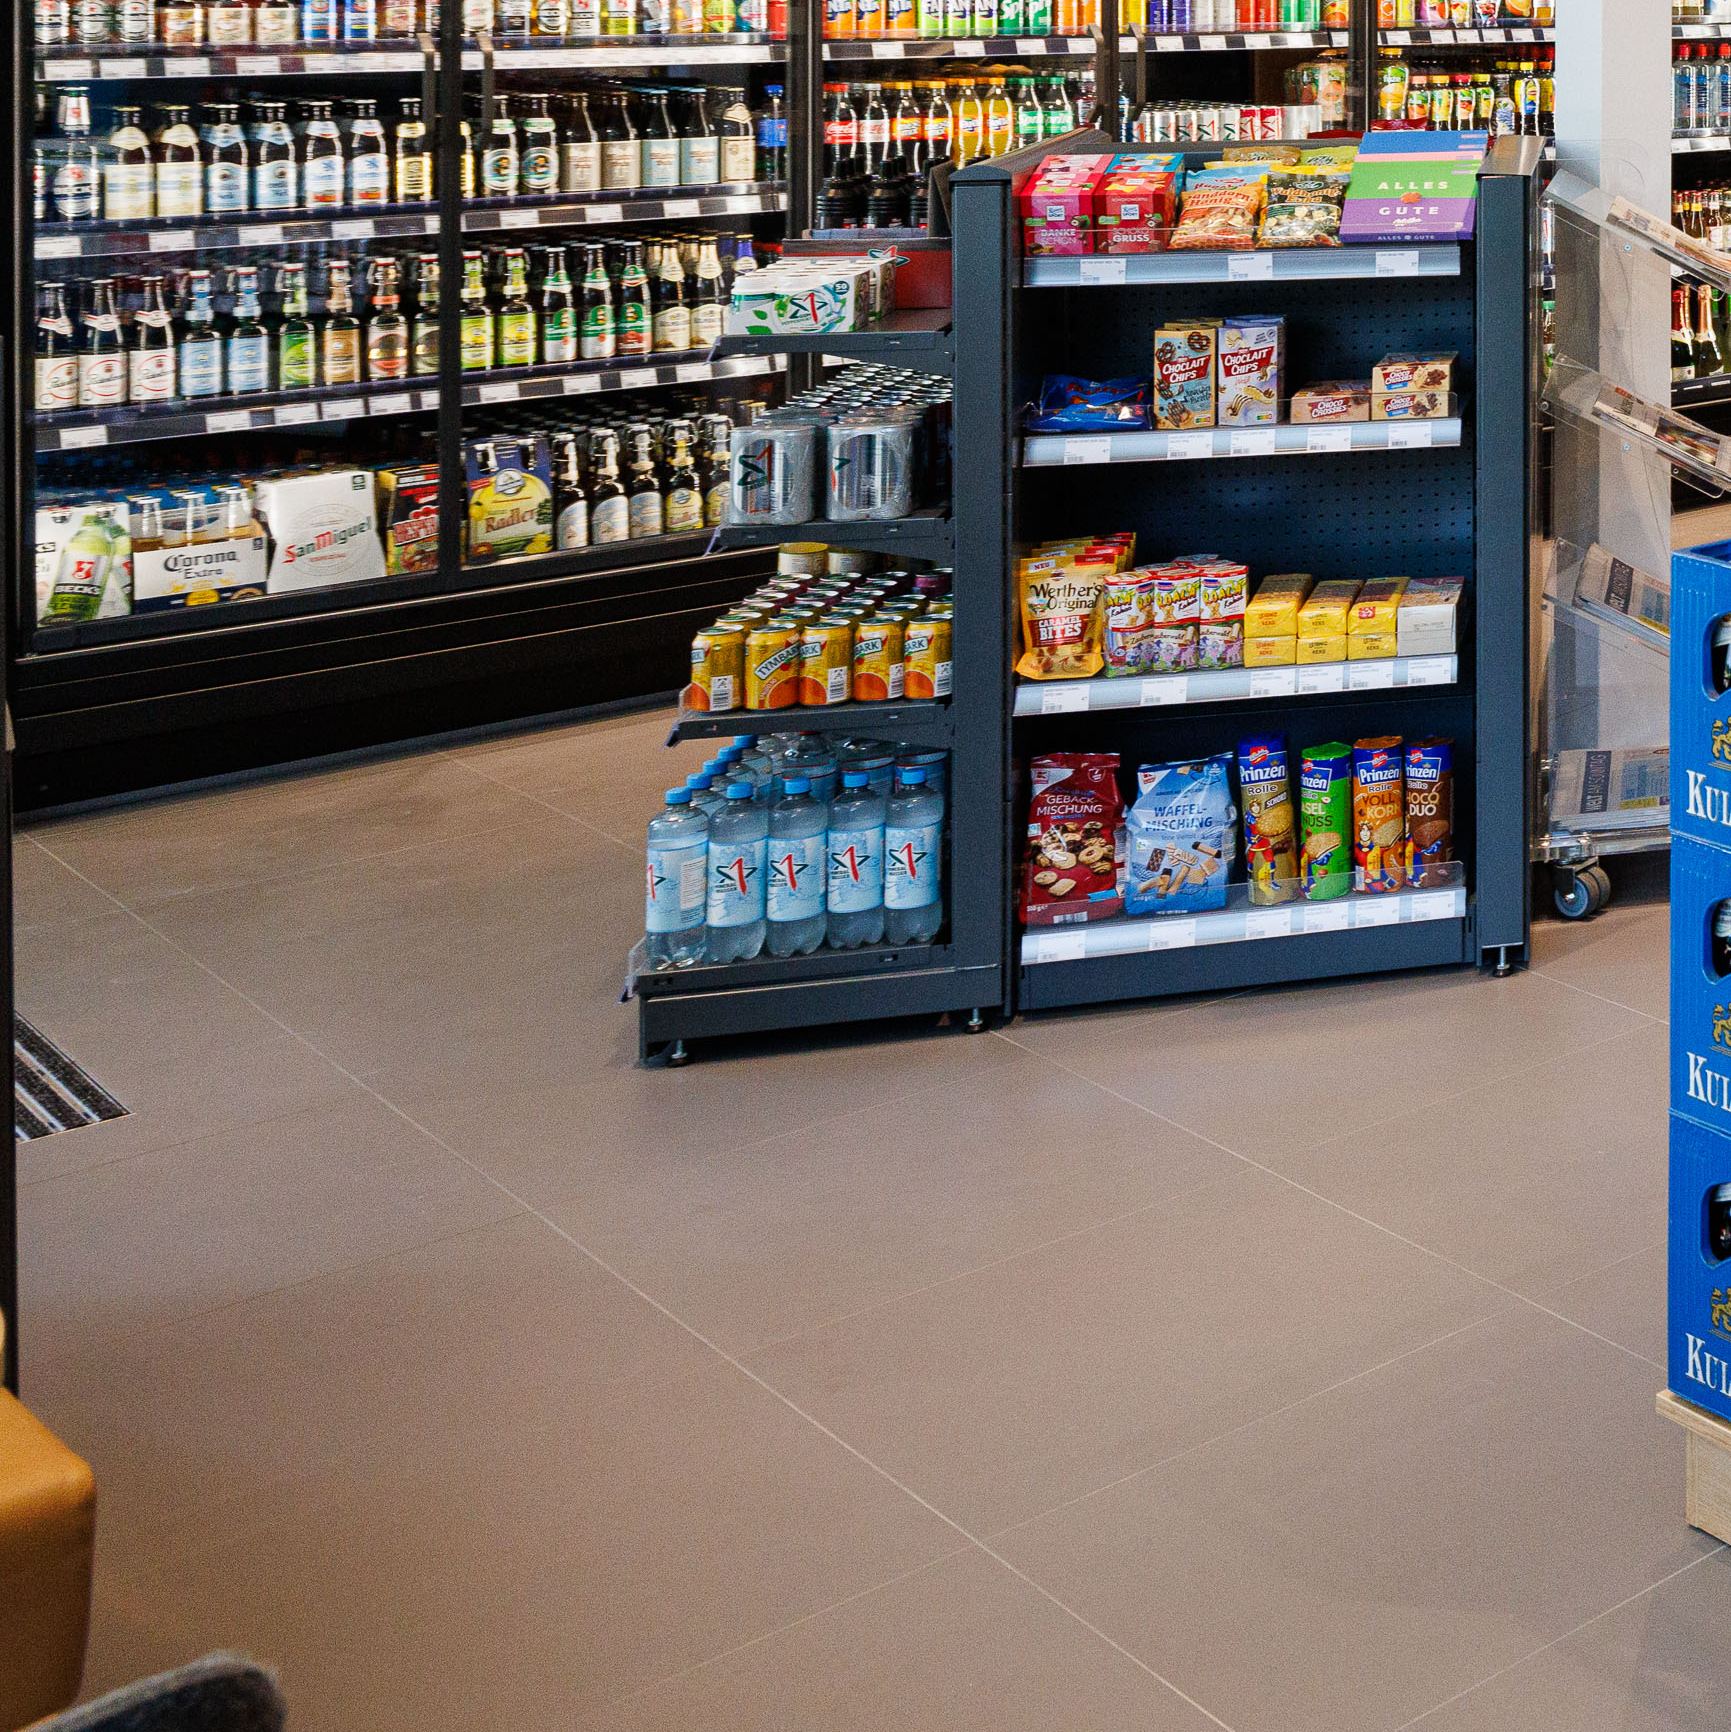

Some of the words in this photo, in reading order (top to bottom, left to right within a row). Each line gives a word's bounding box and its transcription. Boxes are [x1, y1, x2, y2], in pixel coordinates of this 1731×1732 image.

[1377, 181, 1449, 190] ALLES
[1379, 206, 1440, 216] GUTE
[1392, 216, 1423, 227] Milka
[1040, 228, 1076, 237] DANKE
[1113, 233, 1150, 243] GRUSS
[1223, 349, 1269, 366] CHOCLAIT
[1162, 357, 1207, 374] CHOCLAIT
[1231, 362, 1258, 376] CHIPS
[1169, 371, 1198, 385] CHIPS
[1389, 370, 1412, 379] CHOCO
[1317, 399, 1344, 410] CHOCO
[1311, 406, 1348, 419] CROSSIES
[283, 539, 315, 564] San
[314, 516, 373, 550] Miguel
[164, 548, 239, 573] Corona
[1033, 561, 1051, 571] NEU
[183, 566, 224, 580] Extra
[1030, 583, 1103, 599] Werther's
[1047, 596, 1098, 613] Original
[1038, 615, 1082, 629] CARAMEL
[1039, 624, 1082, 641] BITES
[1239, 764, 1286, 783] Prinzen
[1359, 767, 1400, 785] Prinzen
[1405, 764, 1437, 779] rinzen
[1247, 783, 1278, 795] Rolle
[1301, 775, 1328, 790] inzen
[1367, 783, 1393, 794] Rolle
[1362, 793, 1395, 806] VOLL
[1036, 804, 1103, 817] MISCHUNG
[1154, 802, 1208, 818] WAFFEL-
[1366, 805, 1400, 819] KORN
[1409, 804, 1437, 817] DUO
[1144, 816, 1214, 832] MISCHUNG
